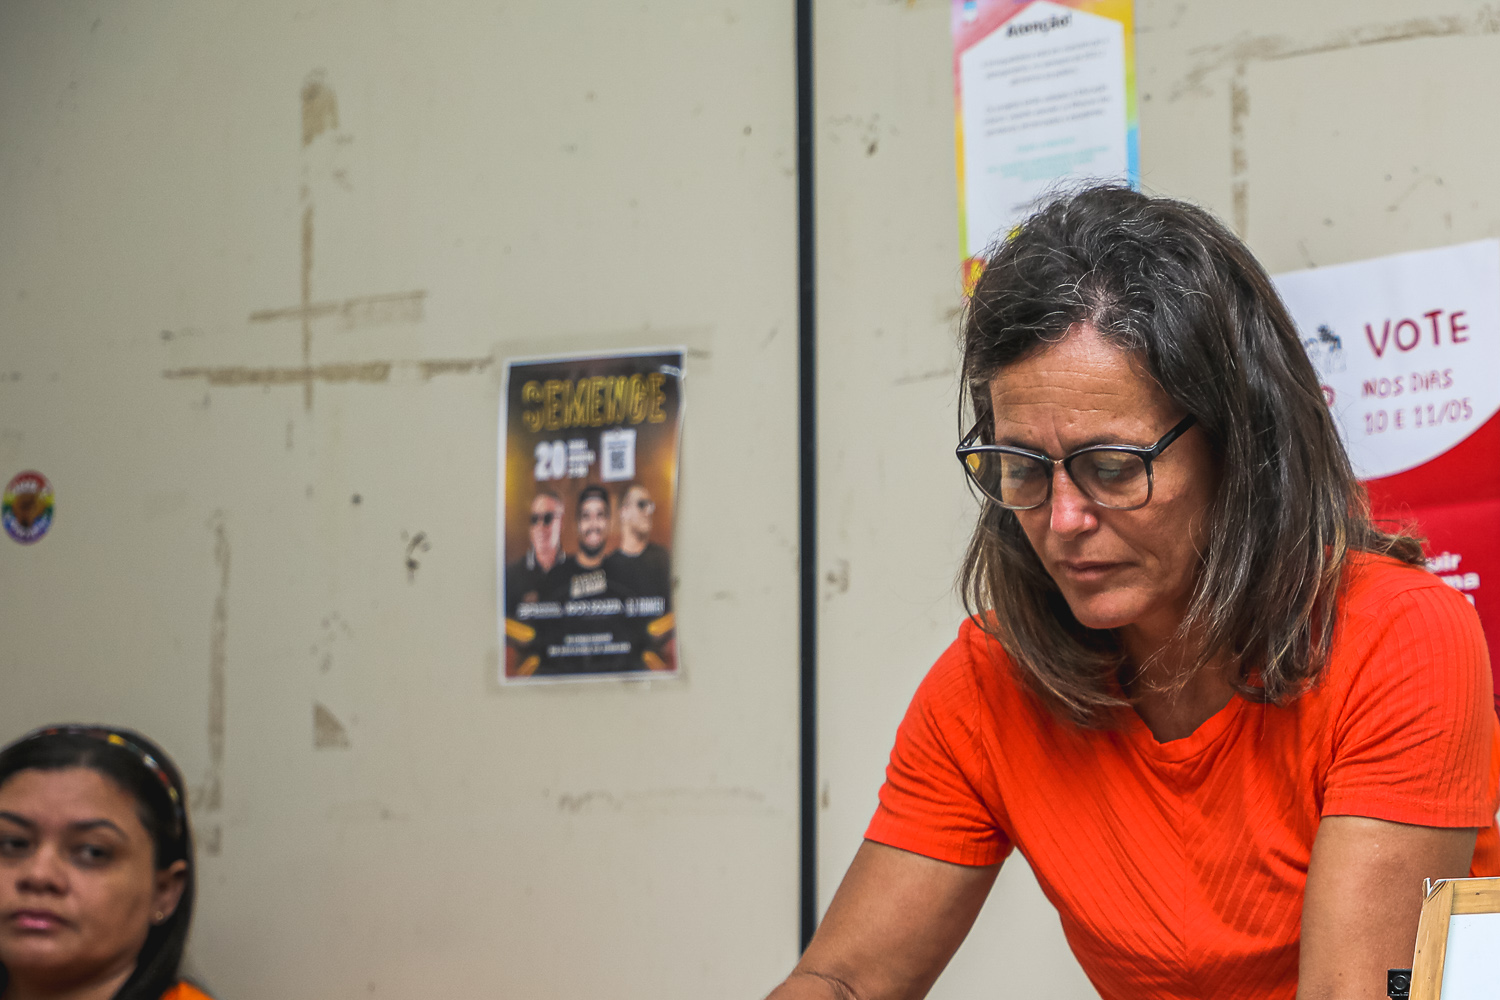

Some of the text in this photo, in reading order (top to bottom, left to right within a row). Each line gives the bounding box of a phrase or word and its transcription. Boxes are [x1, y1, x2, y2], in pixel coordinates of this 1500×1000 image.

[1365, 310, 1470, 359] VOTE
[1361, 375, 1404, 399] NOS
[1364, 409, 1388, 435] 10
[1414, 397, 1473, 428] 11/05
